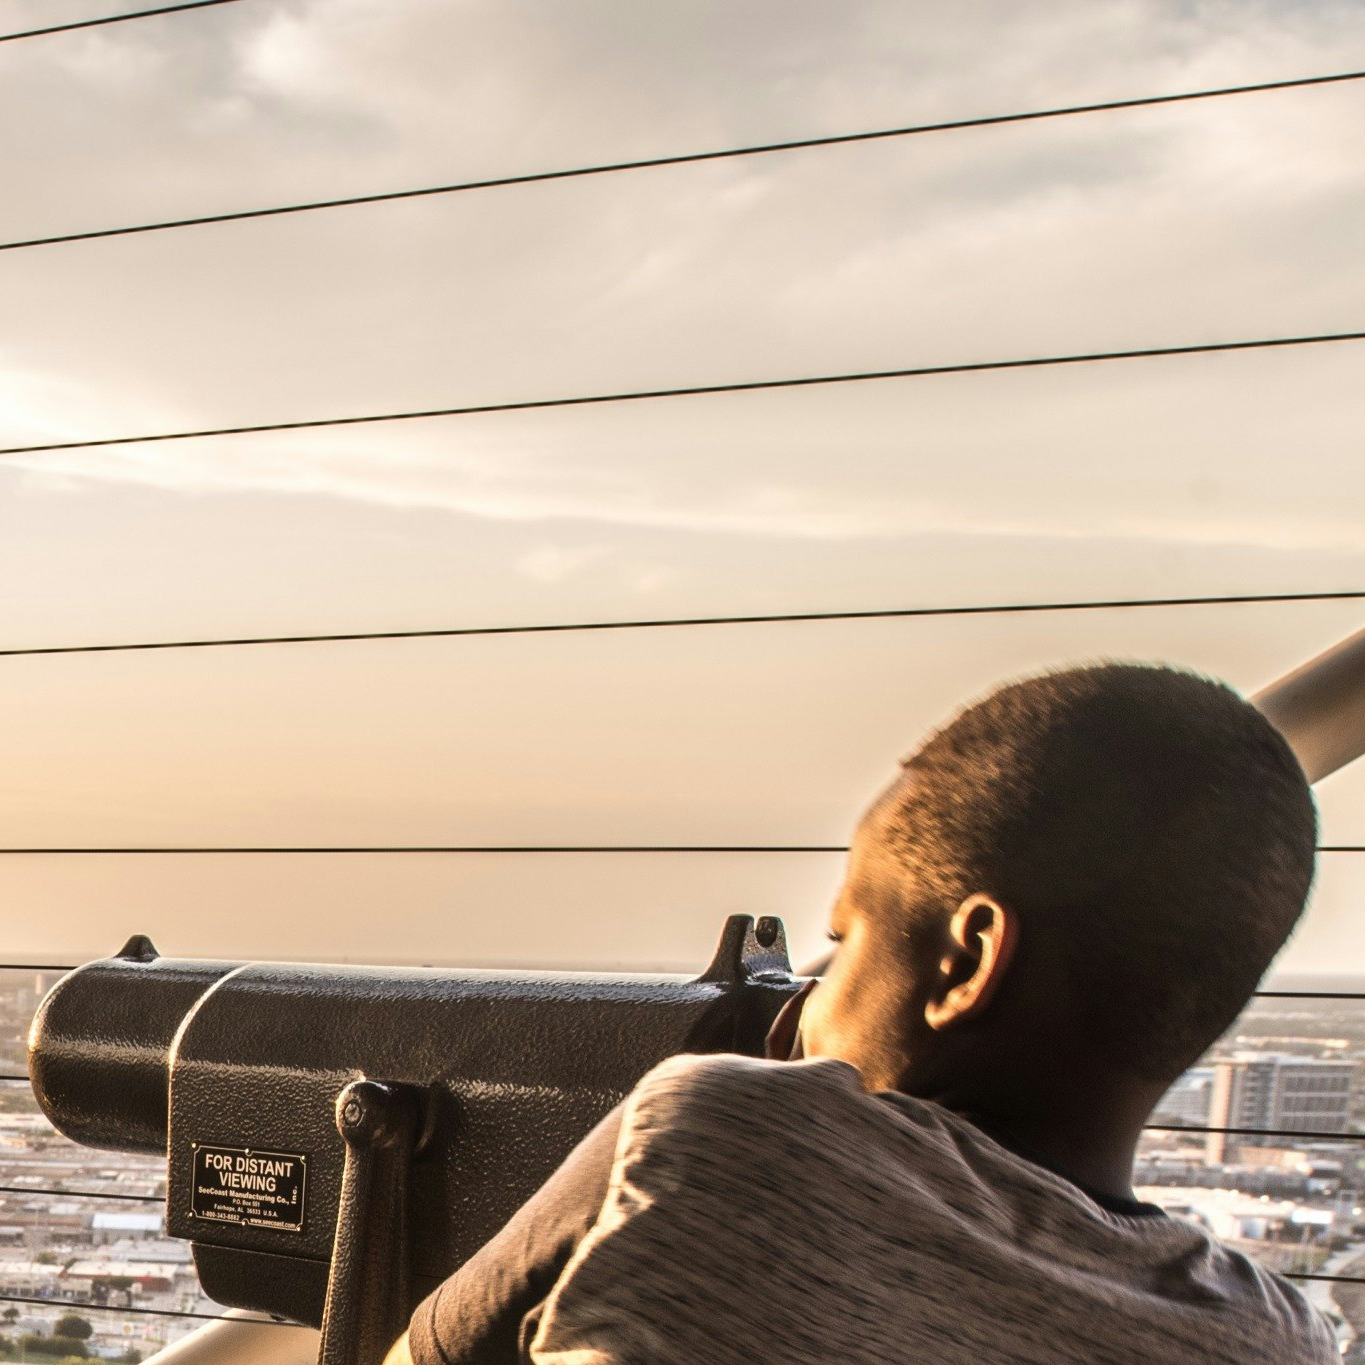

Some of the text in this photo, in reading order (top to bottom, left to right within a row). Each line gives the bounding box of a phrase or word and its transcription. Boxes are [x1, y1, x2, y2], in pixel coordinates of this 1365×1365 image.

[205, 1154, 293, 1177] FOR DISTANT
[219, 1171, 276, 1192] VIEWING
[198, 1186, 290, 1206] SeeCoast Manufacturing Co.,
[242, 1199, 251, 1207] Box
[262, 1209, 279, 1218] U.S.A.
[250, 1218, 296, 1228] www.seecoast.com
